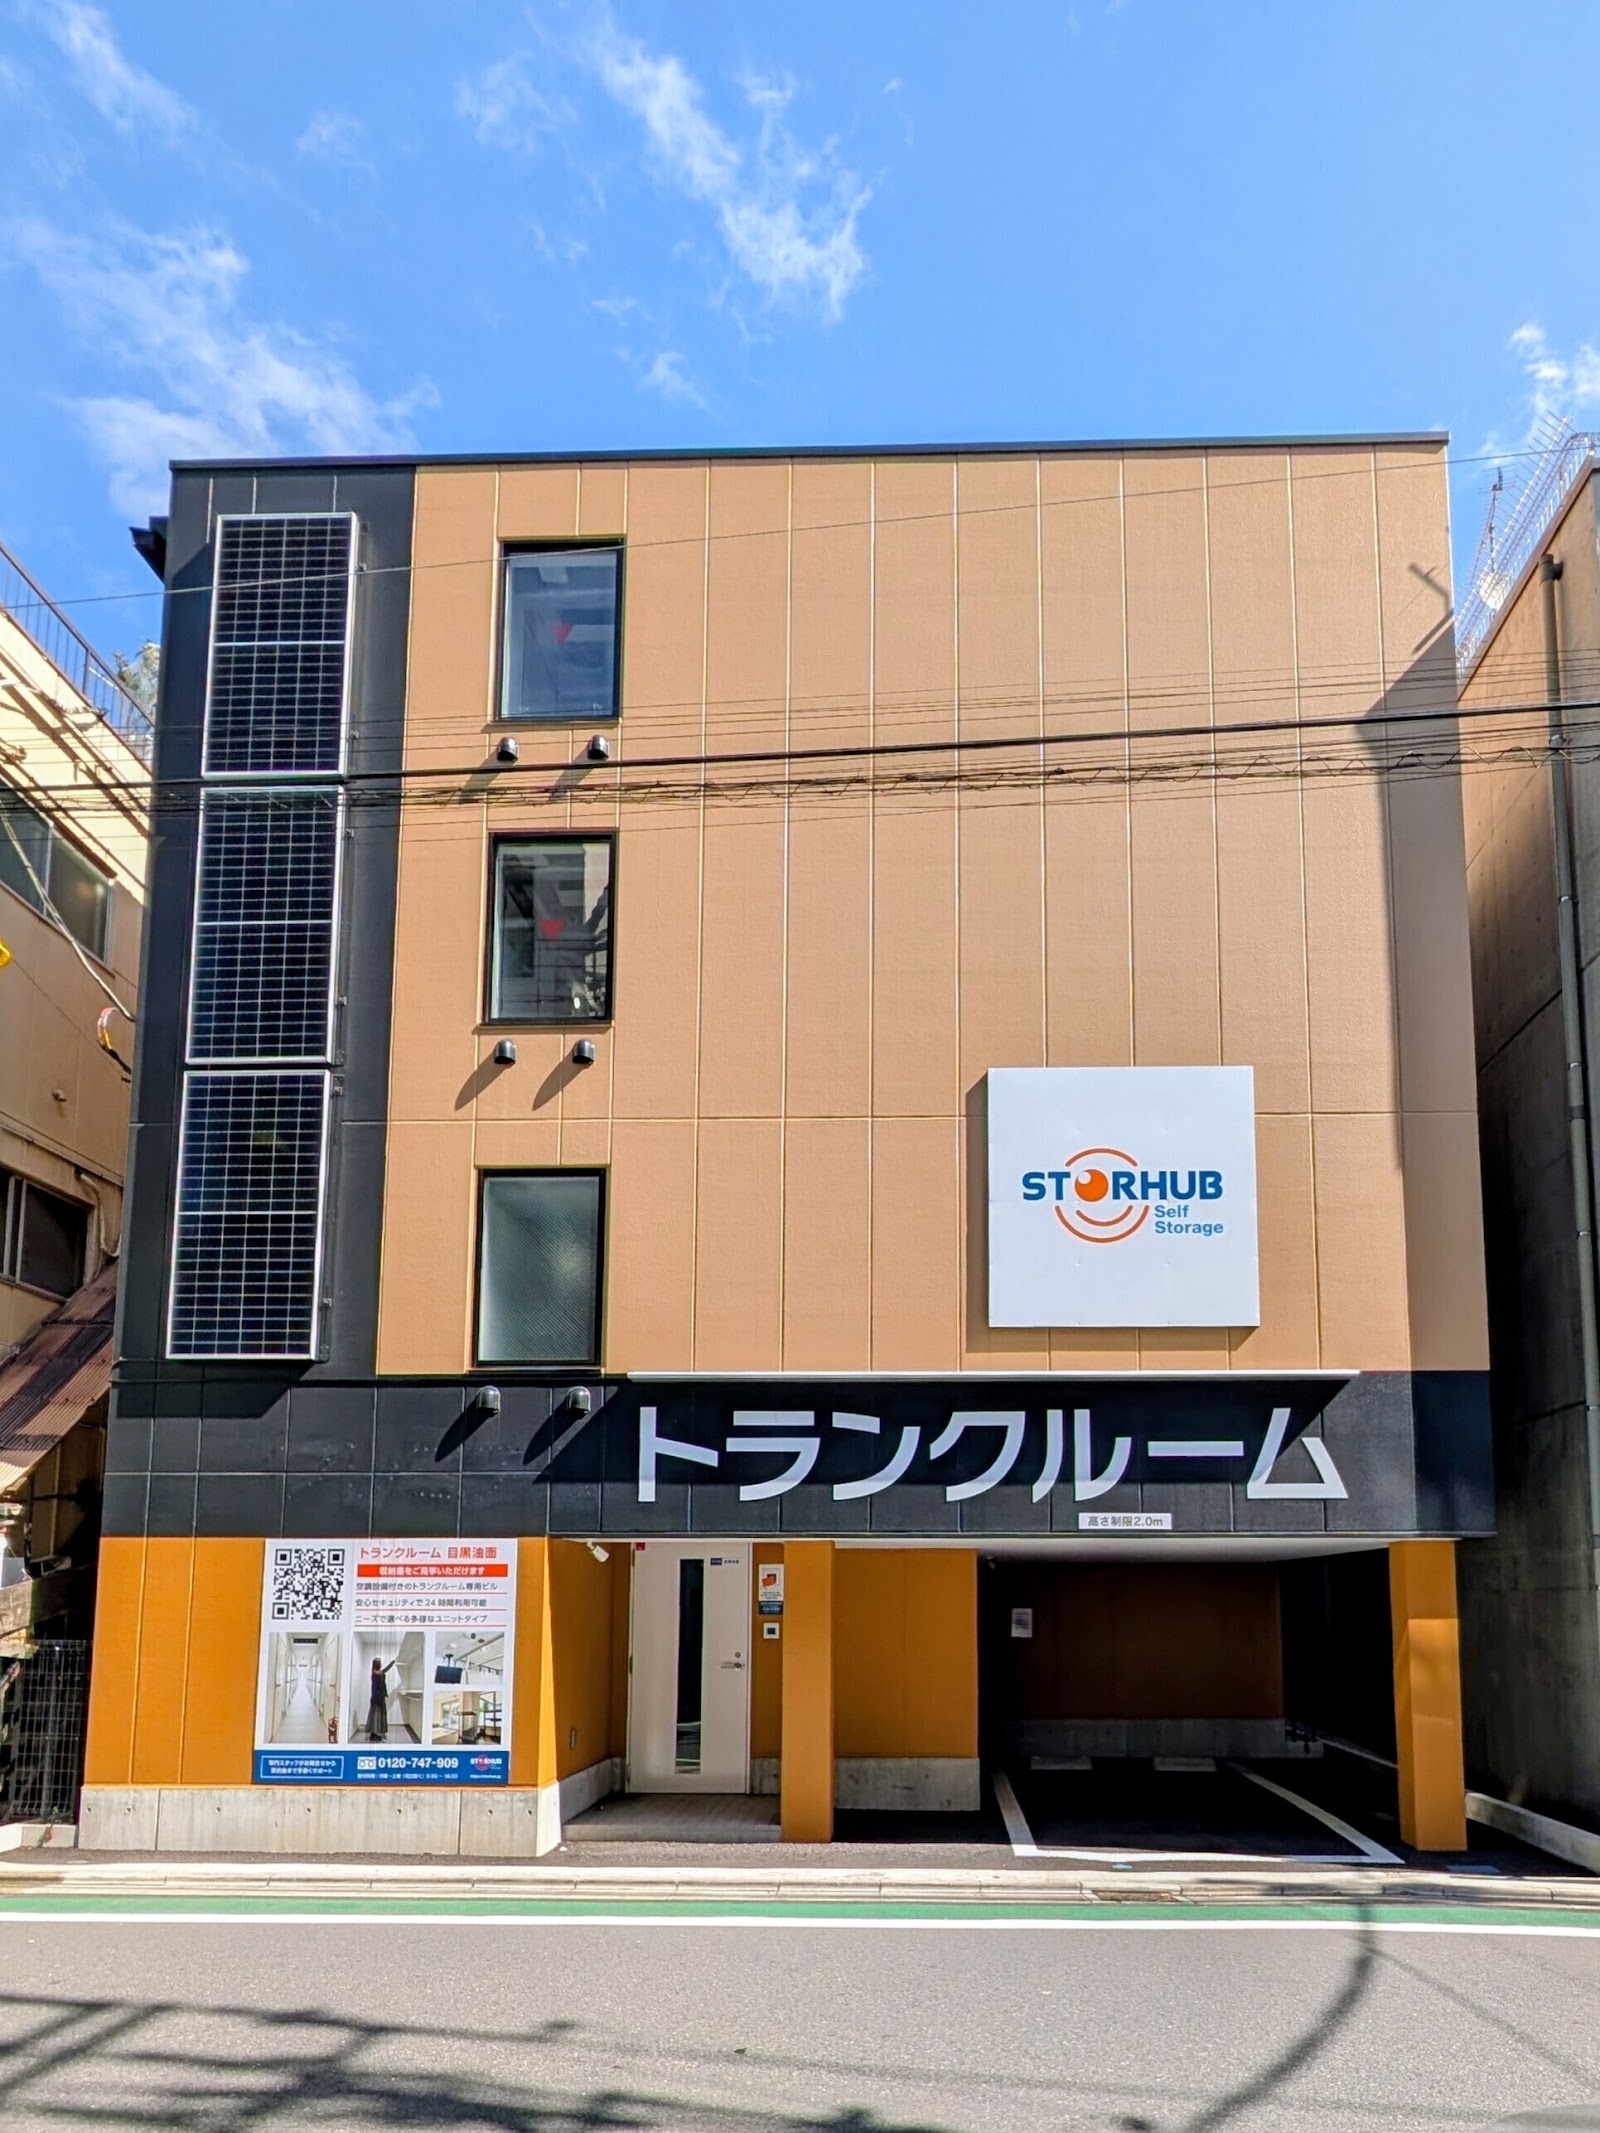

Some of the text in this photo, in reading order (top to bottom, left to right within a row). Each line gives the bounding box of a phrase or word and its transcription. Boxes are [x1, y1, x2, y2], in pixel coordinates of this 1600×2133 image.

[1022, 1169, 1223, 1202] STORHUB
[1154, 1204, 1189, 1218] Self
[1154, 1221, 1224, 1236] Storage
[637, 1406, 1349, 1502] トランクルーム
[1088, 1516, 1163, 1527] 高さ制限2.0m
[360, 1547, 498, 1559] トランクルーム 目黒油面
[378, 1757, 459, 1769] 0120-747-909
